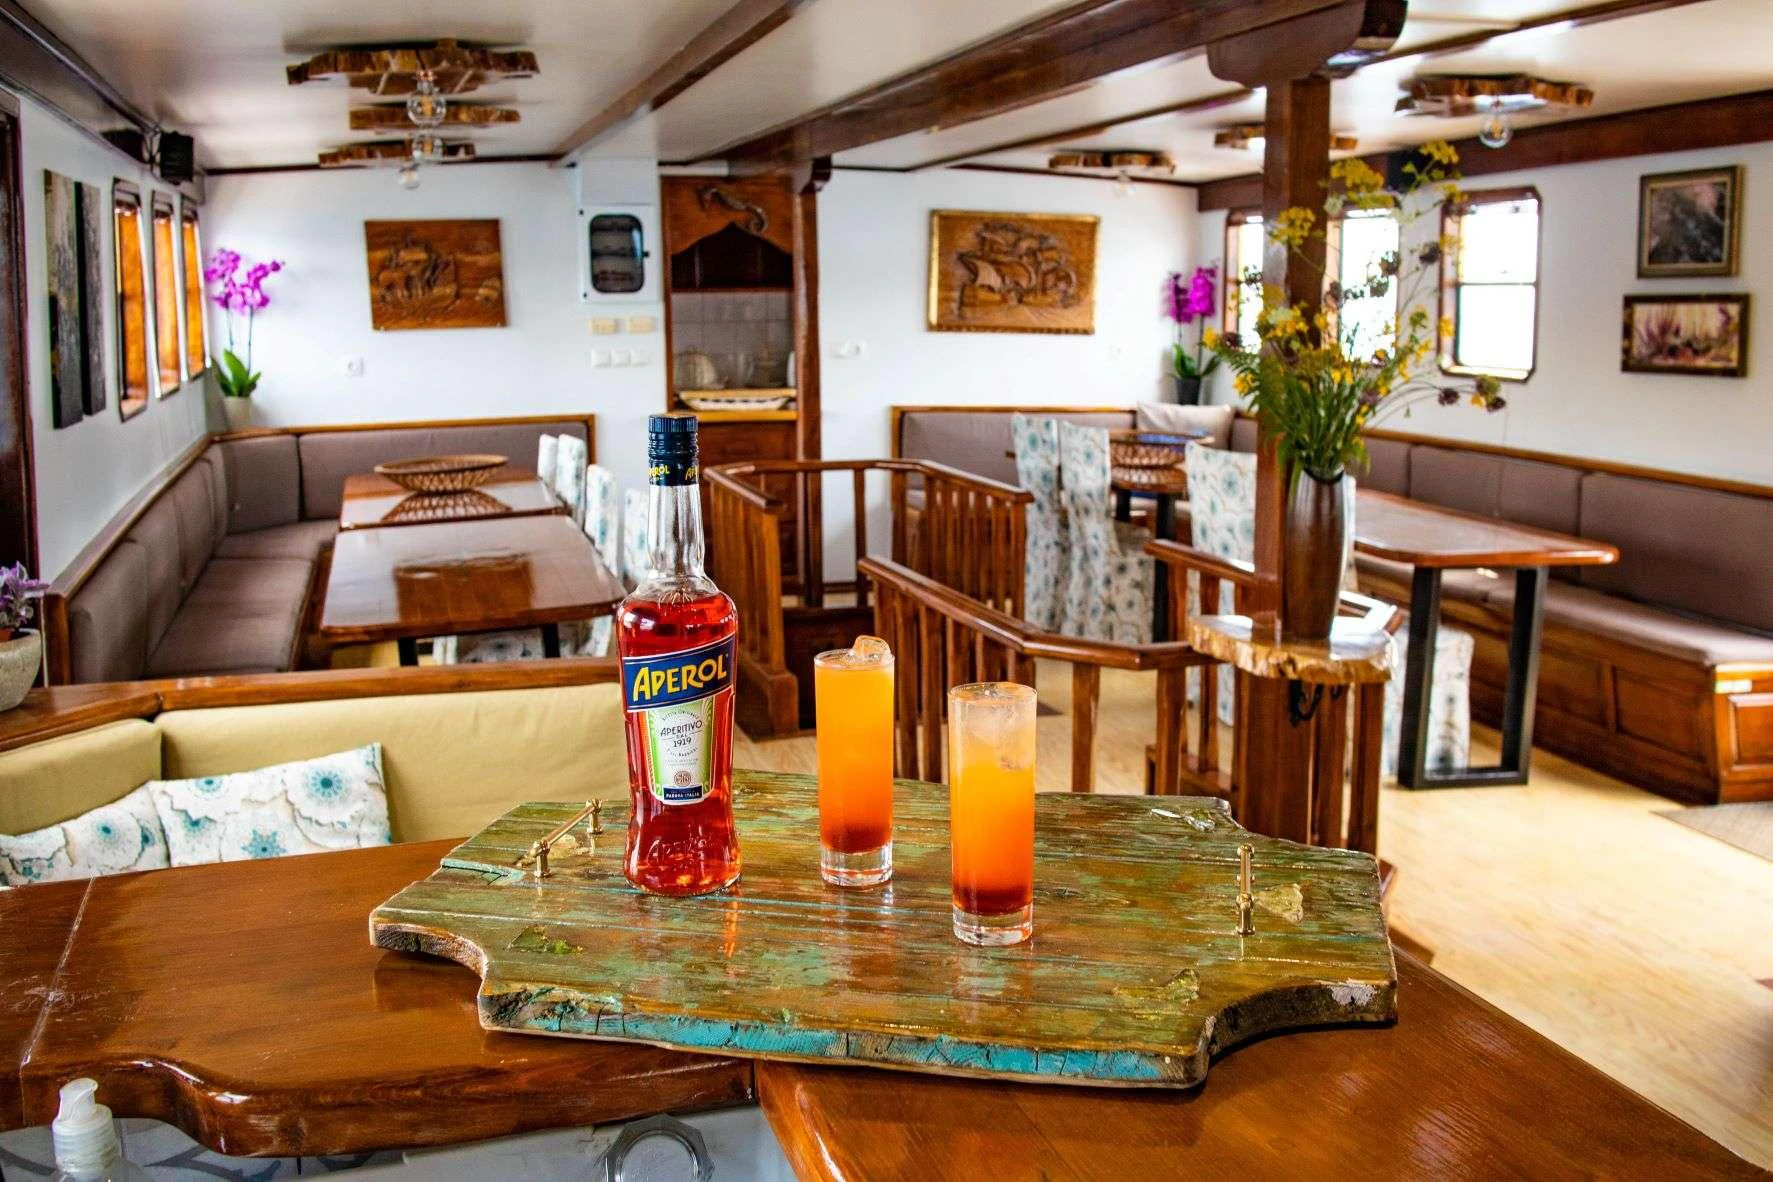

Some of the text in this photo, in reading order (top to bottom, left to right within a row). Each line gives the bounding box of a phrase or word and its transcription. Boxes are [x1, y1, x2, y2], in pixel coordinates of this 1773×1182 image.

[633, 654, 727, 702] APEROL
[660, 719, 703, 737] APERITIVO
[673, 737, 692, 748] 1919
